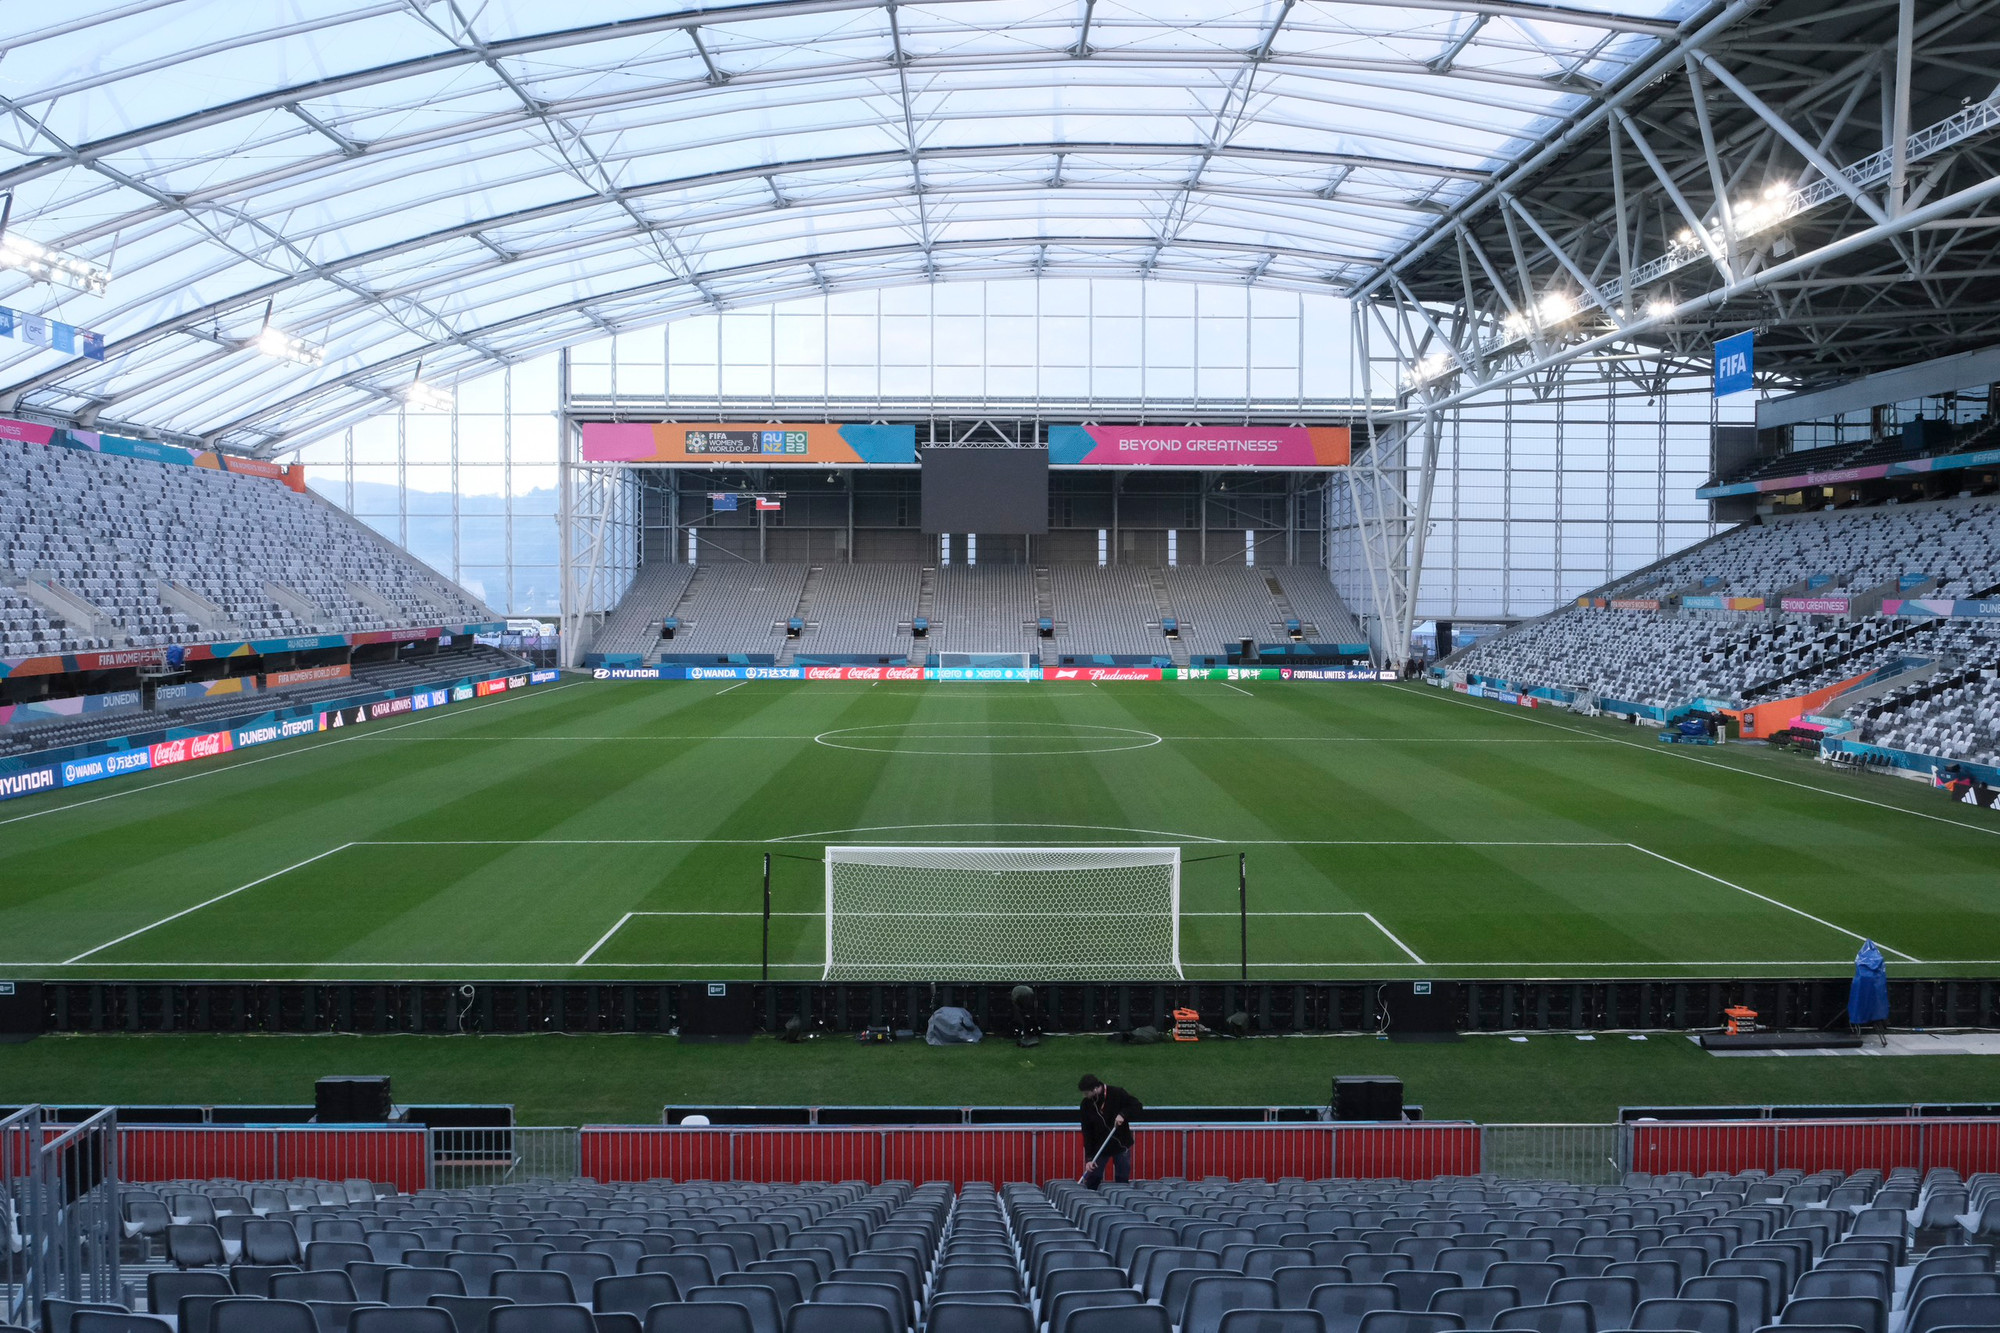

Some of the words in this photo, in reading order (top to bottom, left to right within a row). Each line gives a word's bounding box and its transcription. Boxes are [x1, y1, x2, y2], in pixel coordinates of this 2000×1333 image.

[1719, 352, 1746, 378] FIFA
[708, 432, 727, 440] FIFA
[763, 433, 783, 443] AU
[786, 433, 805, 443] 20
[708, 445, 735, 453] WORLD
[735, 445, 751, 453] CUP
[763, 443, 783, 452] NZ
[786, 443, 805, 453] 23
[1119, 439, 1182, 451] BEYOND
[1780, 600, 1805, 610] BEYOND
[99, 653, 115, 666] FIFA
[278, 674, 290, 684] FIFA
[330, 667, 341, 676] CUP
[612, 669, 660, 678] HYUNDAI
[703, 669, 737, 678] WANDA
[808, 667, 842, 679] Coca-Cola
[847, 667, 881, 679] Coca-Cola
[886, 667, 920, 679] Coca-Cola
[936, 669, 962, 678] xero
[976, 669, 1002, 678] xero
[1089, 669, 1149, 680] Budweiser
[1293, 670, 1324, 679] FOOTBALL
[1324, 670, 1346, 679] UNITES
[103, 692, 139, 707] DUNEDIN
[414, 694, 429, 710] VISA
[432, 690, 446, 705] VISA
[371, 702, 390, 717] QATAR
[390, 698, 412, 712] AIRWAYS
[239, 726, 277, 746] DUNEDIN
[191, 733, 220, 758] Coca-Cola
[154, 740, 186, 766] Coca-Cola
[75, 761, 103, 778] WANDA
